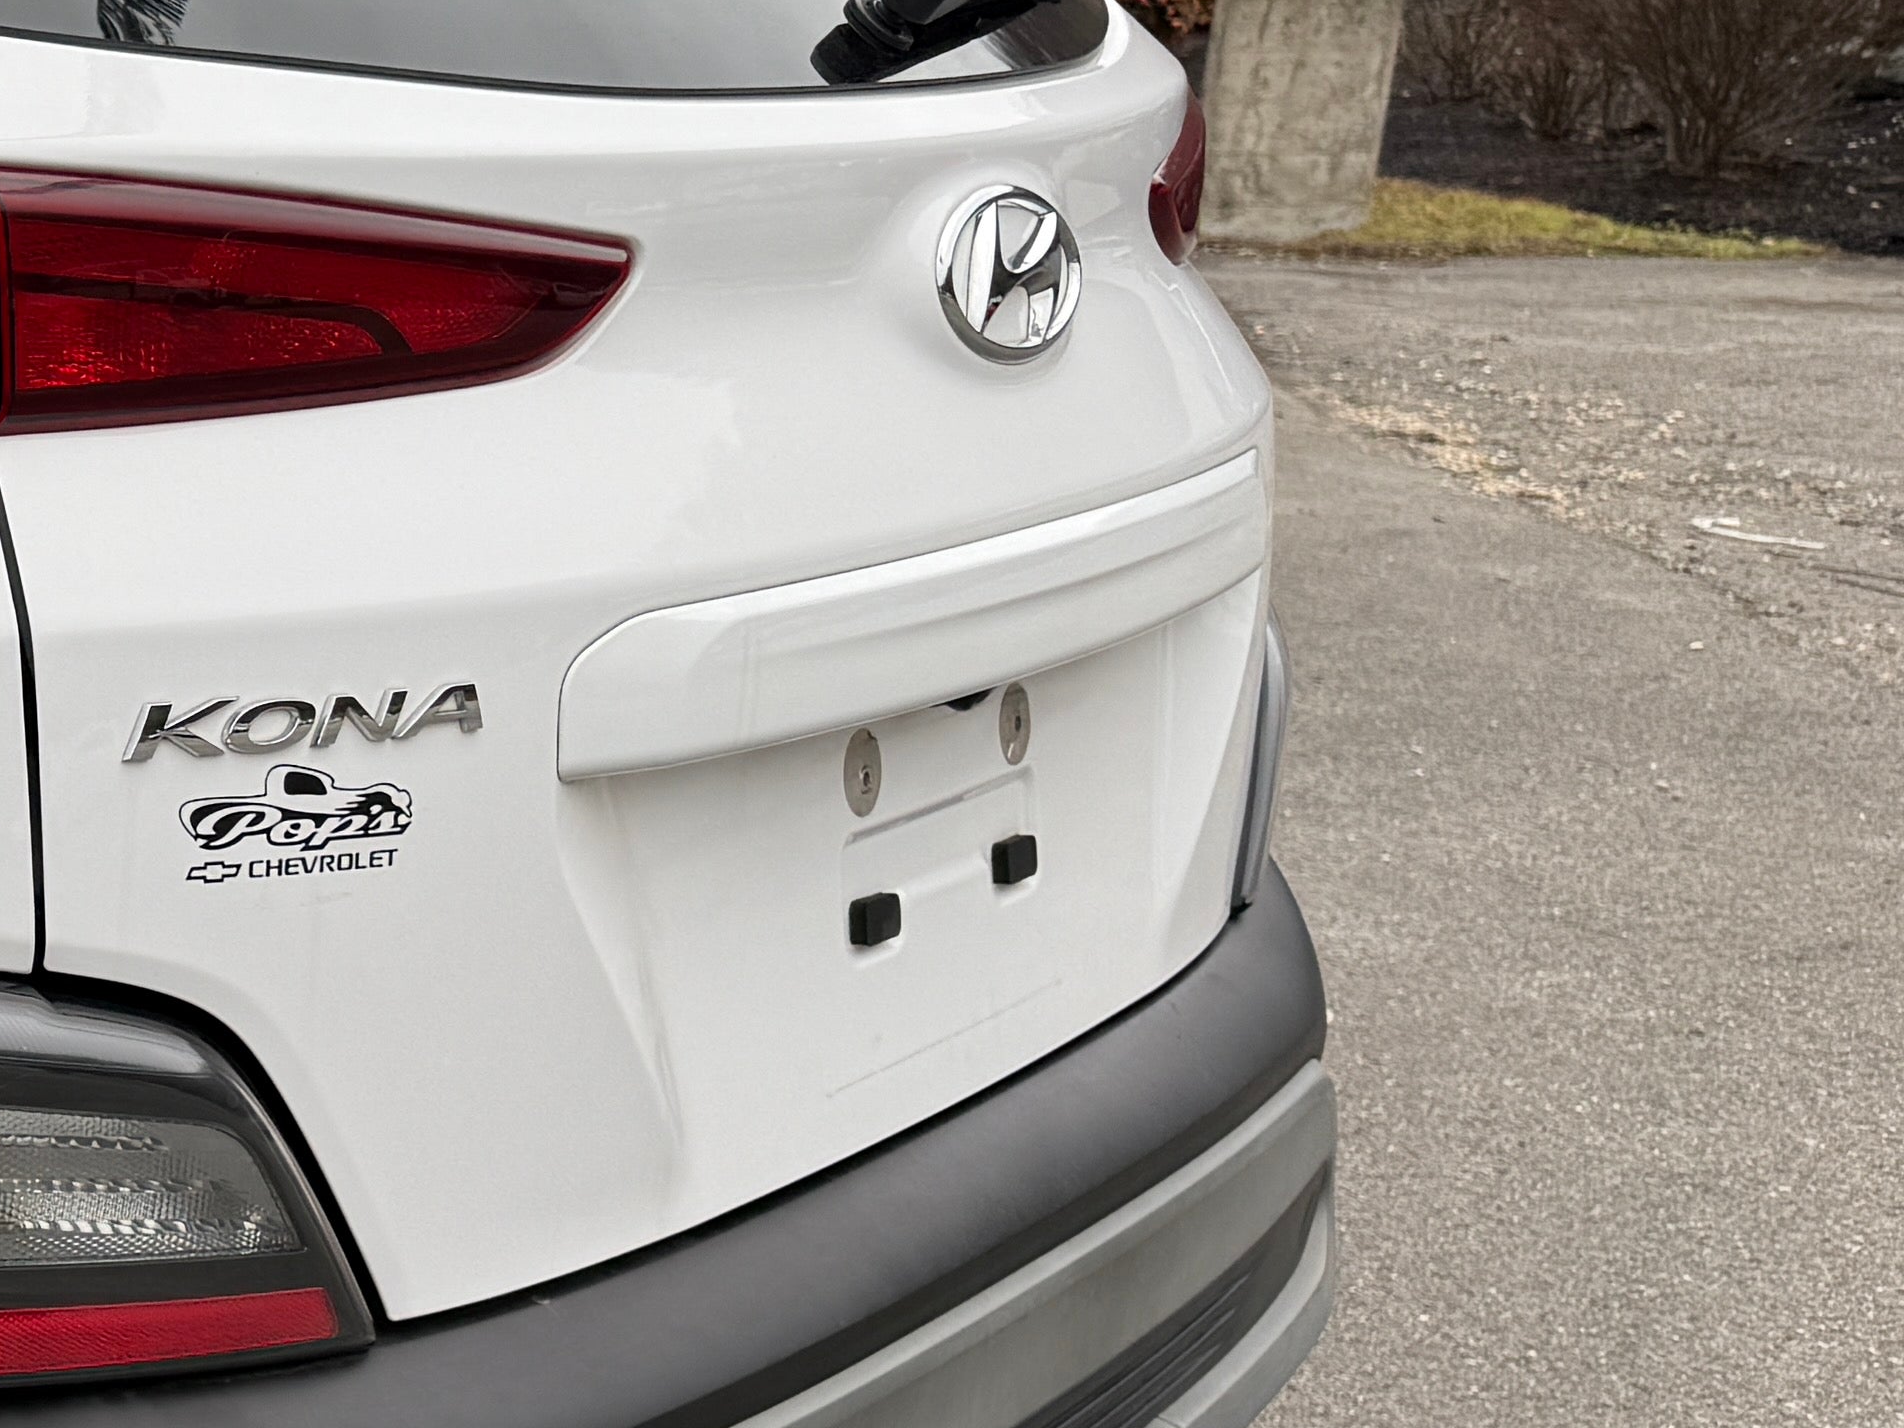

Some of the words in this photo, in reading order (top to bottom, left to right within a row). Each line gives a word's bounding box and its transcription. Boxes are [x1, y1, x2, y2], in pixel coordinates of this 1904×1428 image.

[121, 682, 484, 763] KONA
[195, 803, 413, 852] Pop's
[248, 848, 399, 880] CHEVROLET
